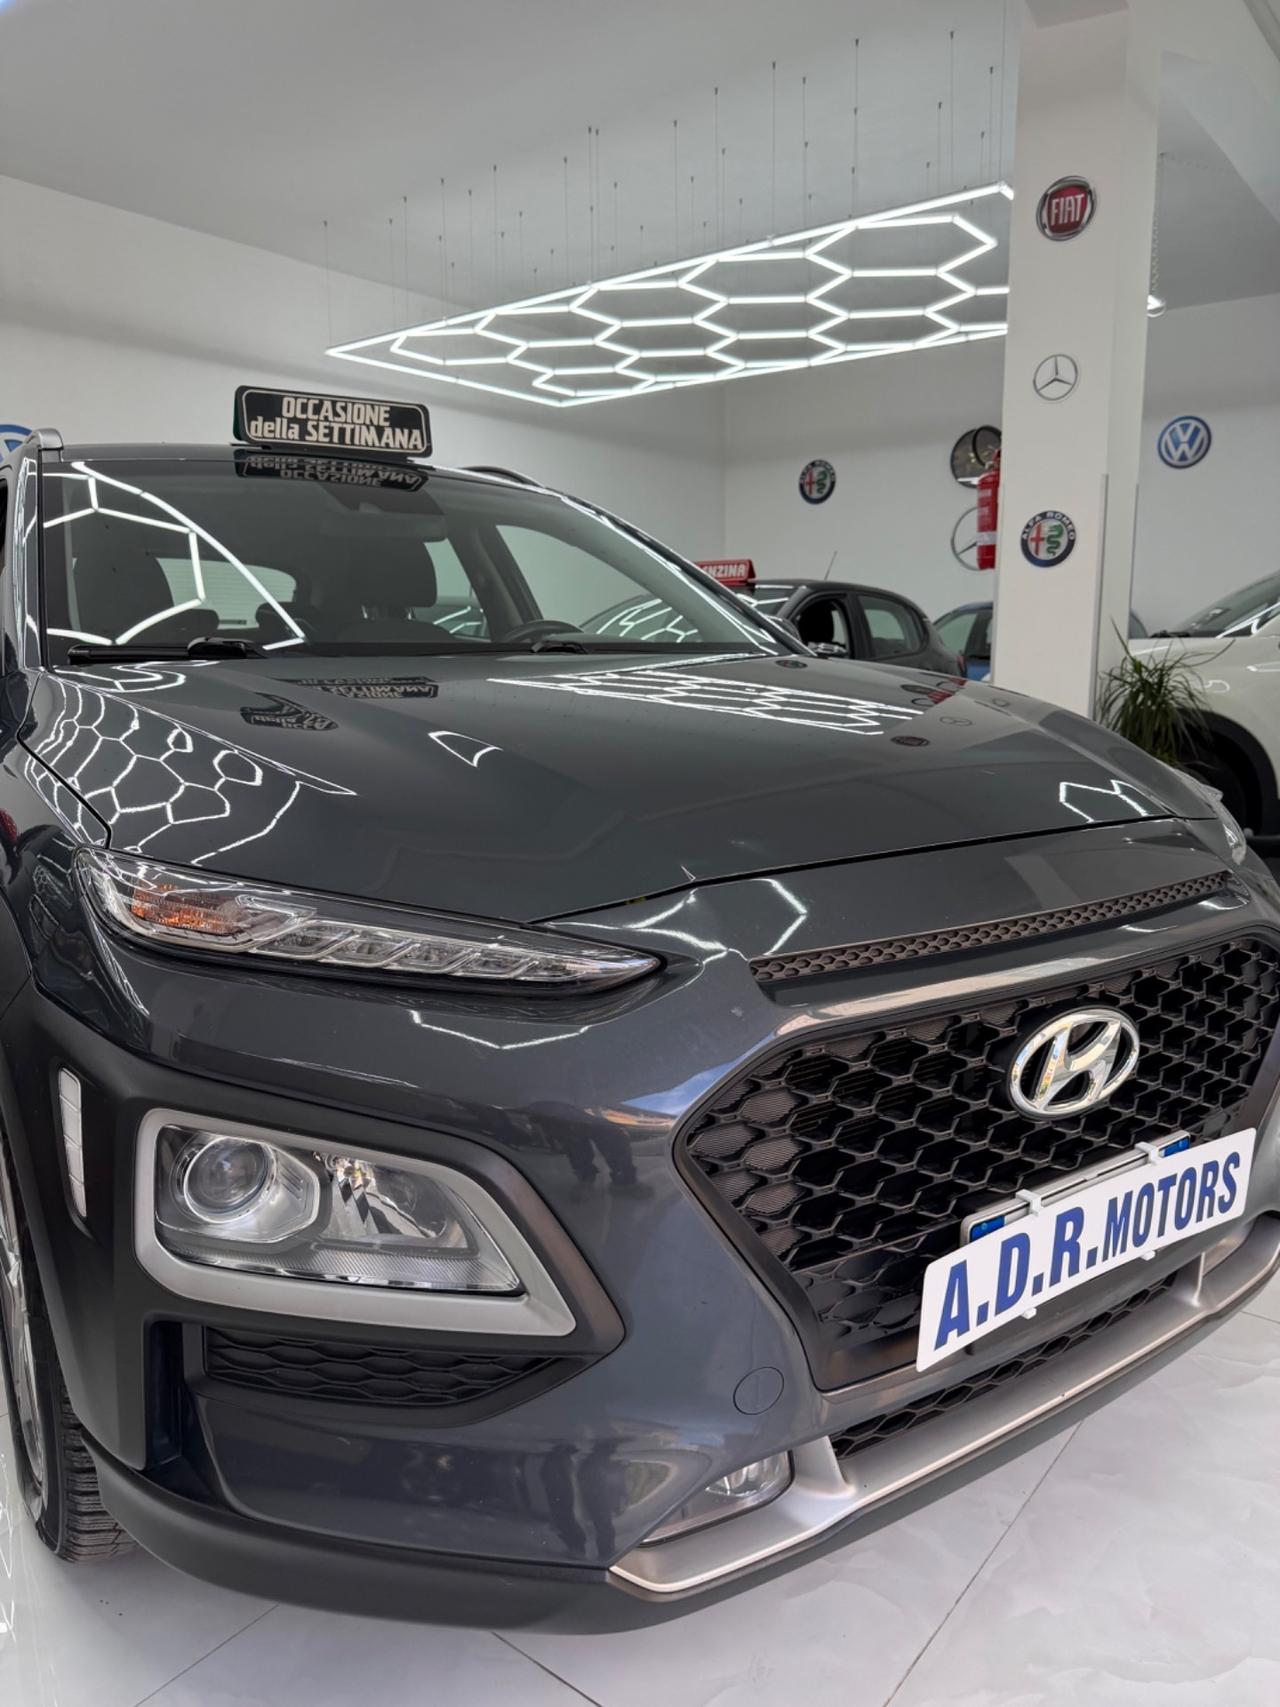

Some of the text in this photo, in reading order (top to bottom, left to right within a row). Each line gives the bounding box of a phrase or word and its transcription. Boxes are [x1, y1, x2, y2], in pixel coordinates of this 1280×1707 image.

[1051, 193, 1085, 226] FIAT
[282, 396, 390, 426] OCCASIONE
[250, 415, 422, 449] della SETTIMANA
[1046, 511, 1076, 540] ROMEO
